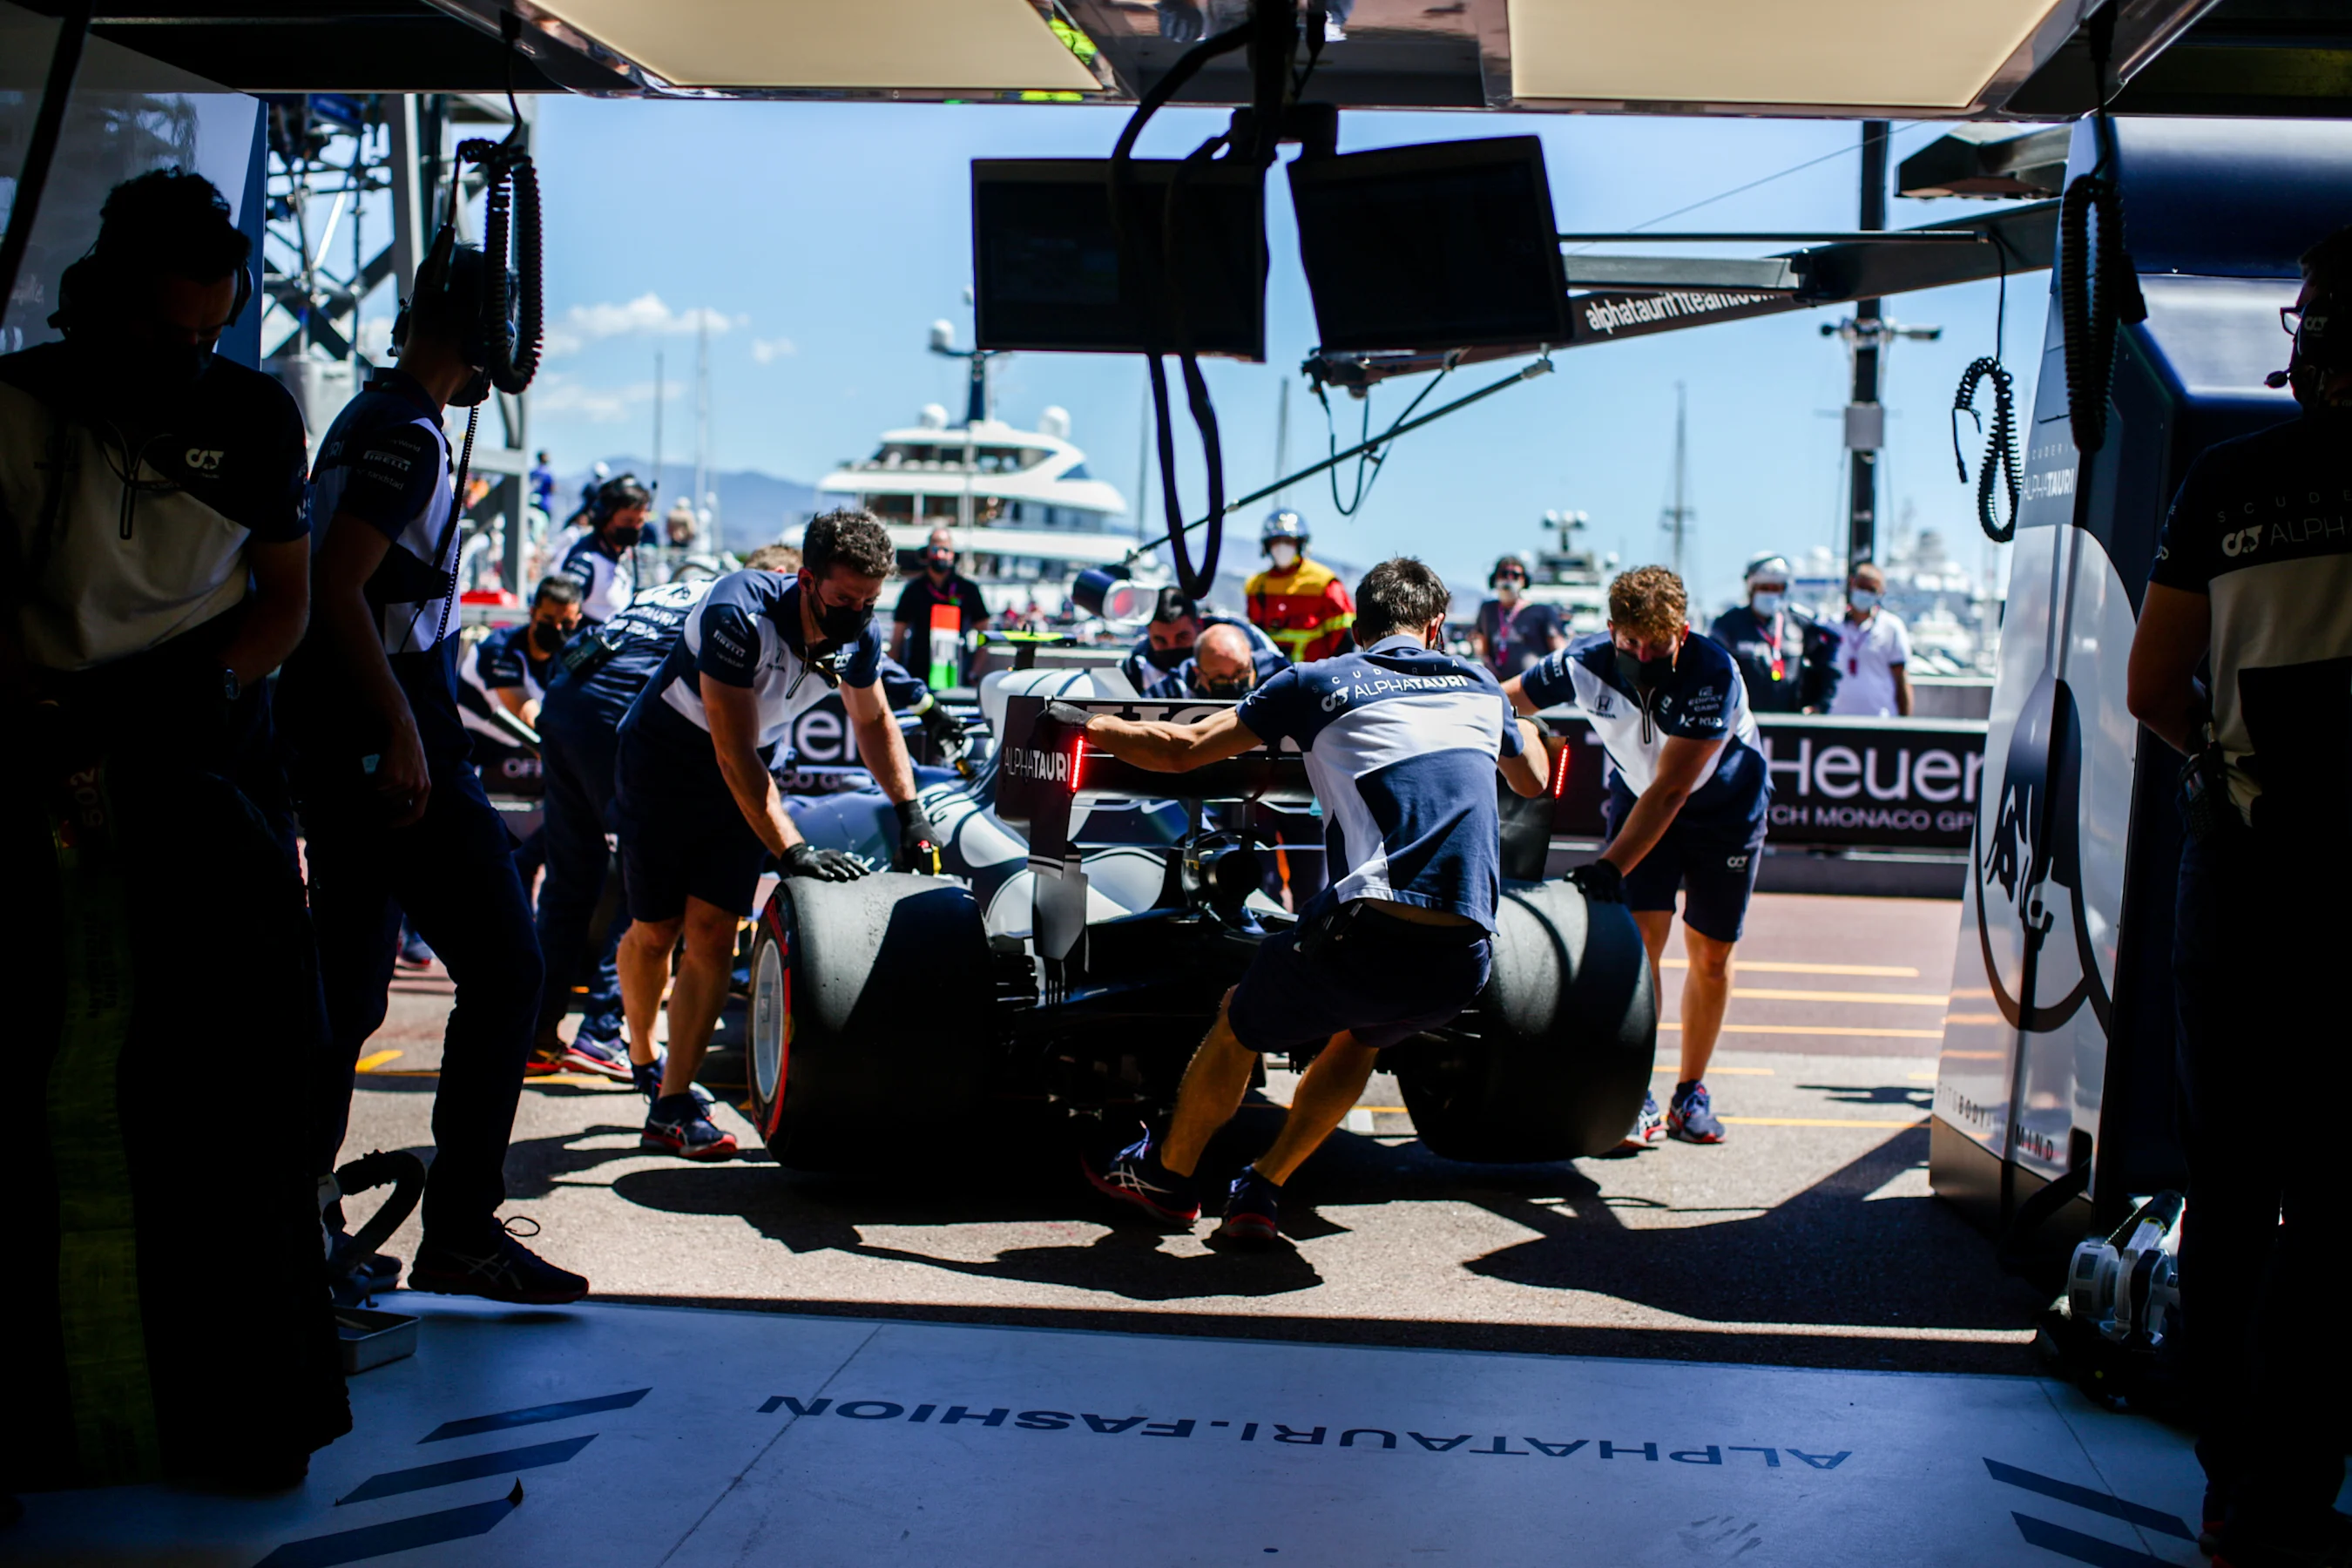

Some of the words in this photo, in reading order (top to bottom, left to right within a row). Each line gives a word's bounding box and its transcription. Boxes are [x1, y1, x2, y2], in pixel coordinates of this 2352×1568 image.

[362, 449, 411, 472] PIRELLI
[1311, 659, 1460, 693] SCUDRIA
[1355, 674, 1469, 700] ALPHATAURI
[1004, 747, 1071, 782] ALPHATAURI
[1815, 805, 1931, 831] MONACO
[1936, 810, 1975, 832] GP
[1958, 1094, 1986, 1129] BODY
[2015, 1123, 2054, 1162] MIND
[755, 1396, 1853, 1470] ALPHATAURI.FASHION
